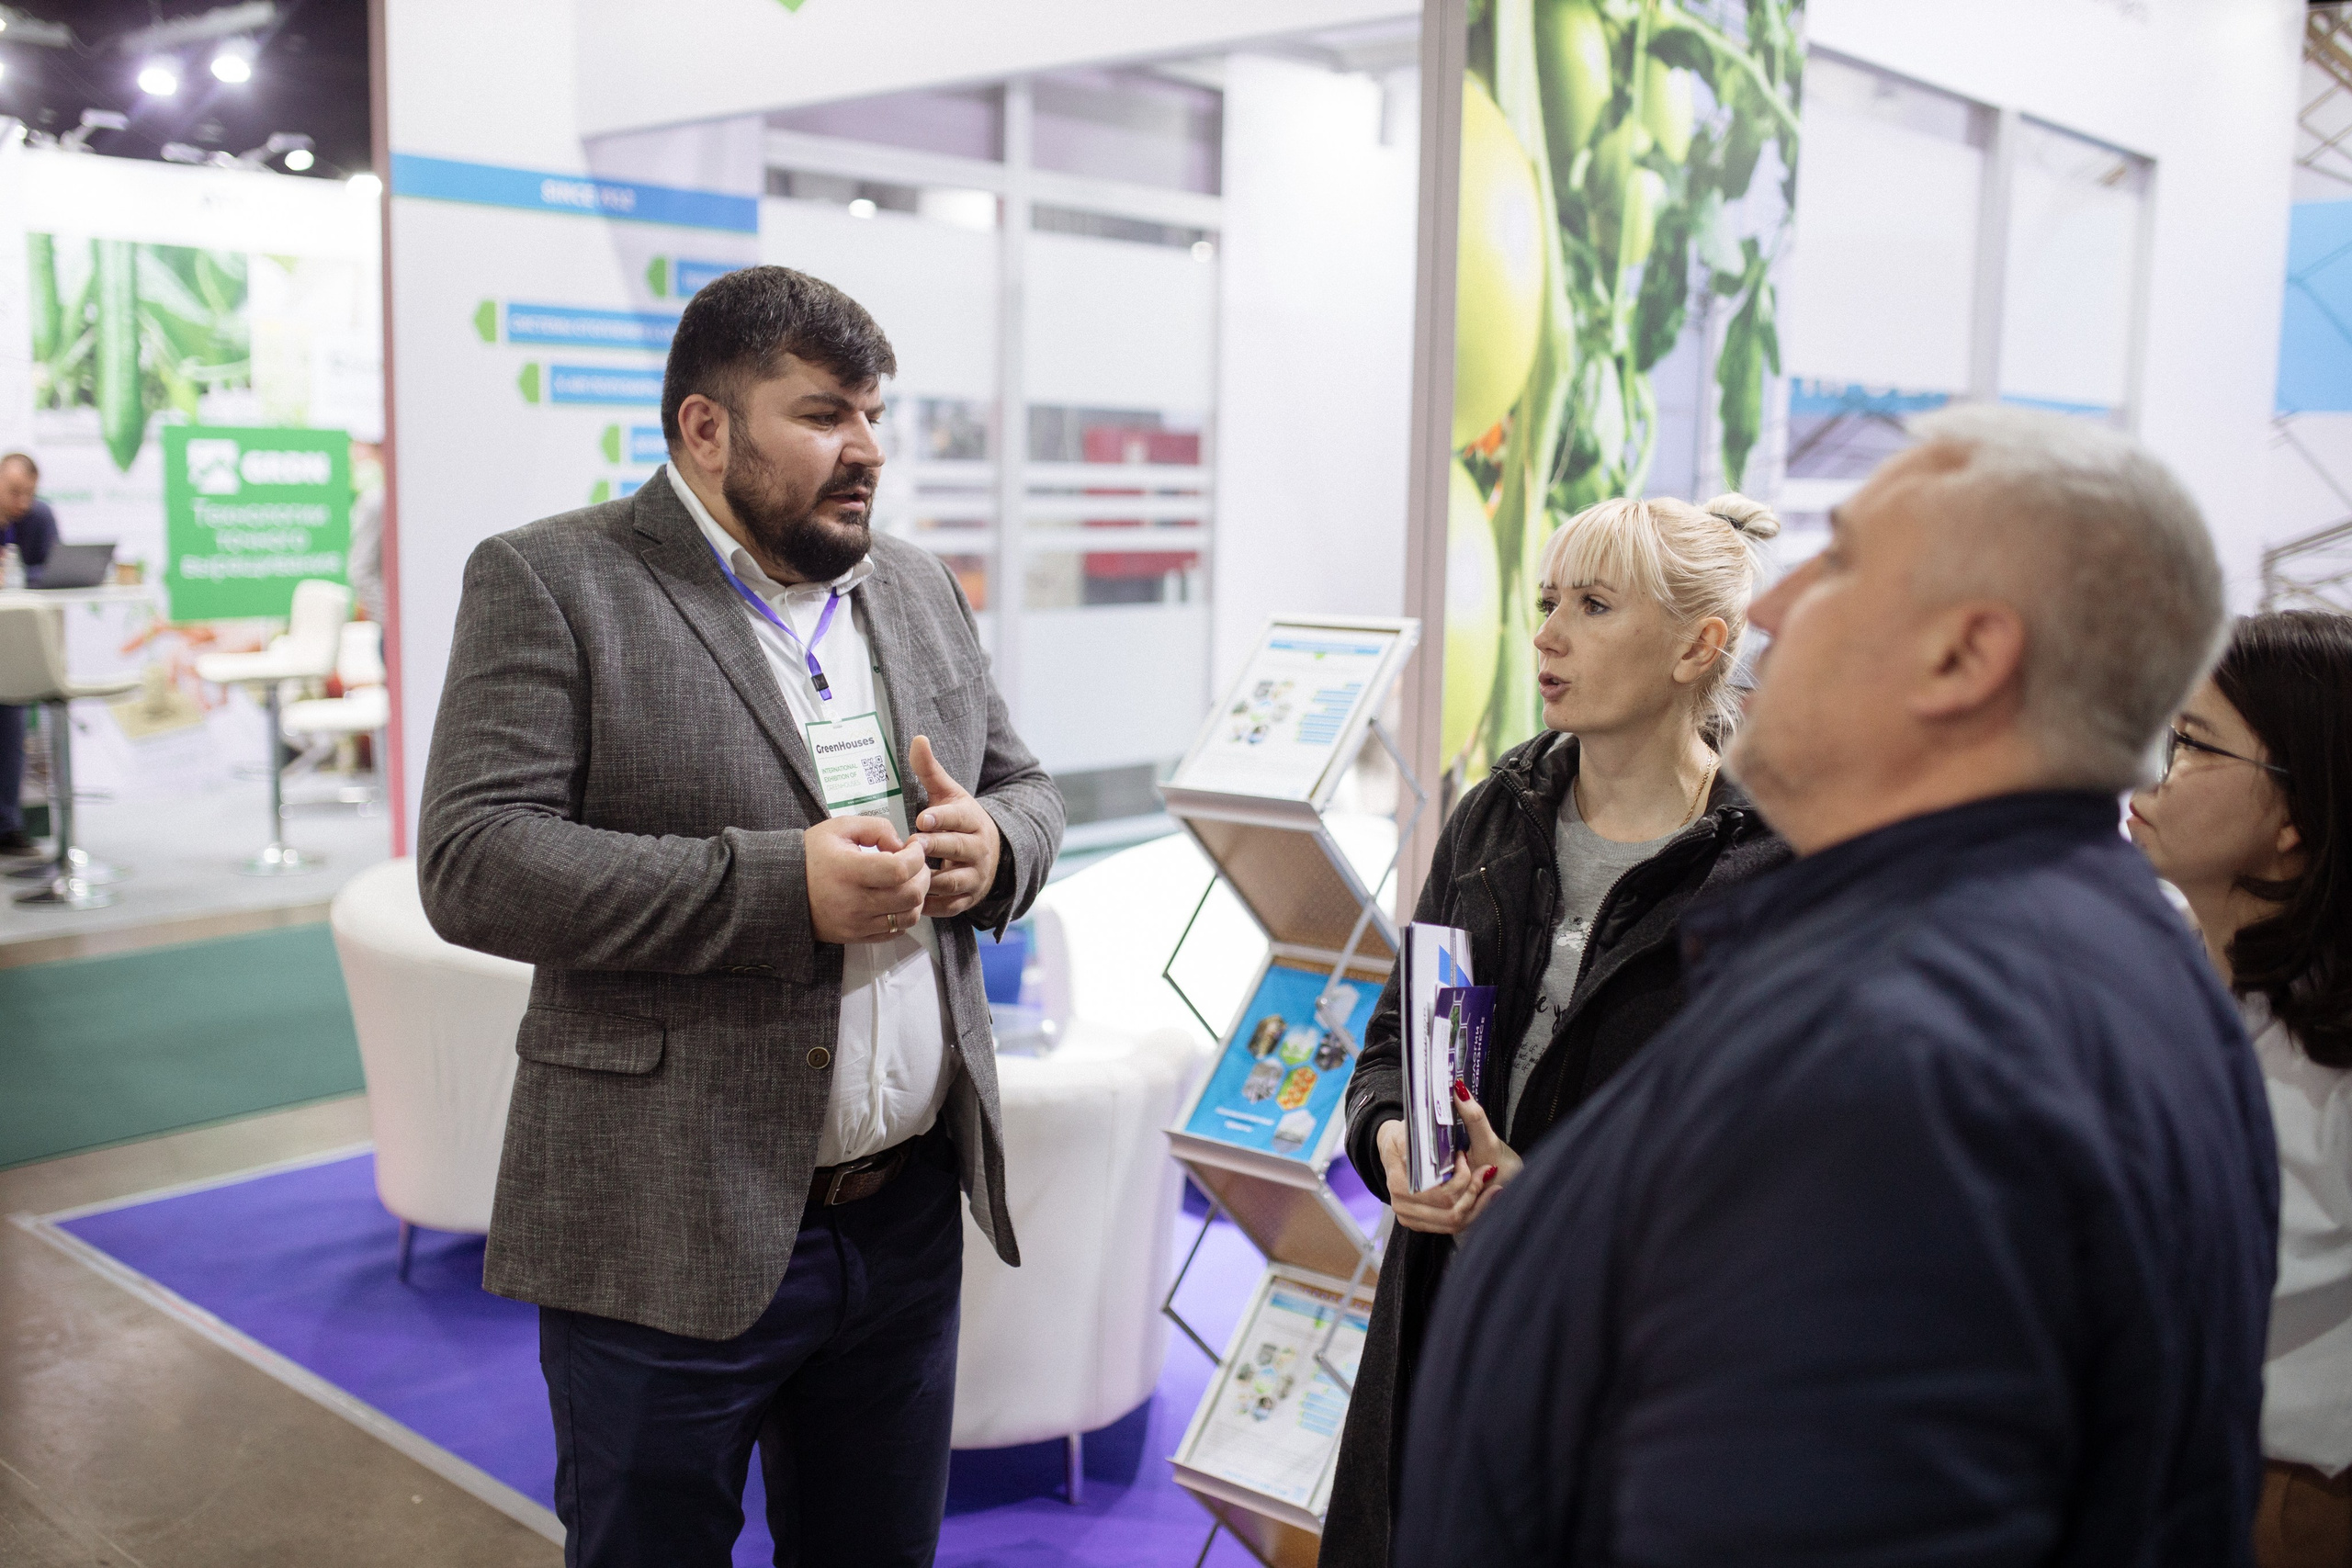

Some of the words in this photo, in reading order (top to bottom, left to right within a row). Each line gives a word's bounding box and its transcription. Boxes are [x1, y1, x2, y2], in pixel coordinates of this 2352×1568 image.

[816, 737, 875, 754] GreenHouses
[821, 763, 859, 774] INTERNATIONAL
[823, 773, 849, 784] EXHIBITION
[849, 772, 857, 780] OF
[1475, 1016, 1486, 1101] ГРОБИЗНЕСЕ
